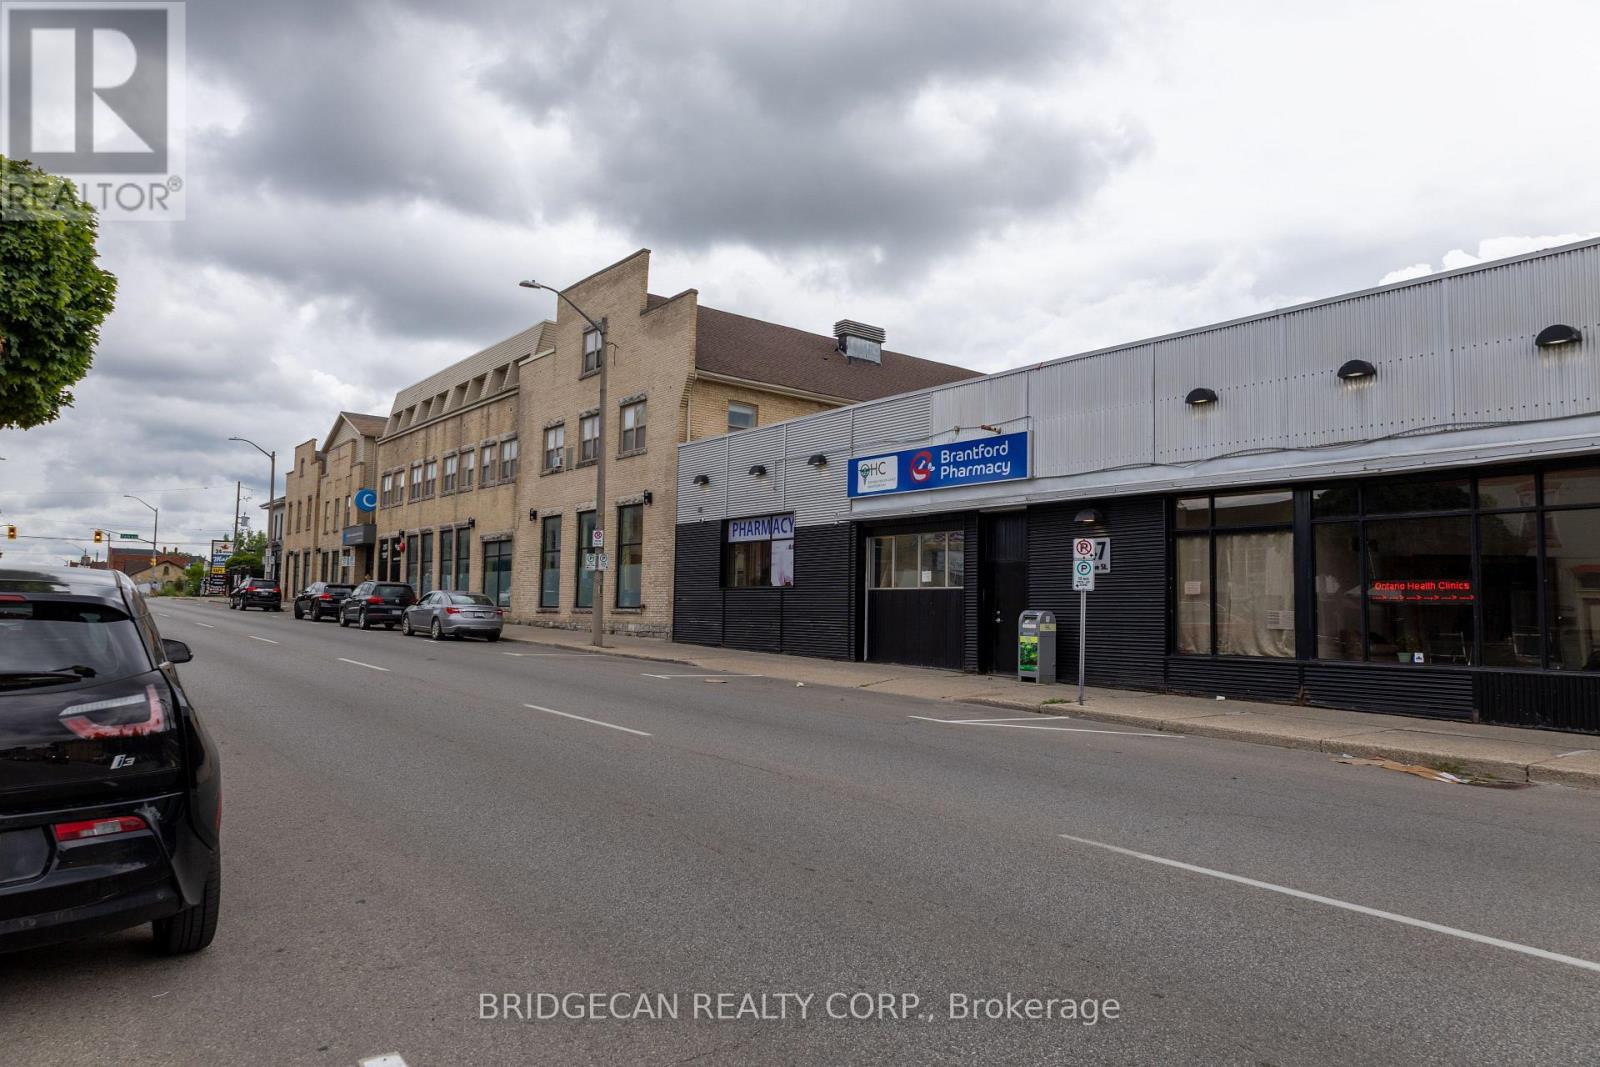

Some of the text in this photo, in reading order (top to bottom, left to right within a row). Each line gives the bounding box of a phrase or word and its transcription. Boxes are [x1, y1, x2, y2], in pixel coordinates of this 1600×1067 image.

[940, 440, 1009, 464] Brantford
[940, 460, 1011, 480] Pharmacy
[732, 517, 795, 537] PHARMACY
[1407, 582, 1436, 590] Health
[1438, 581, 1470, 590] Clinics
